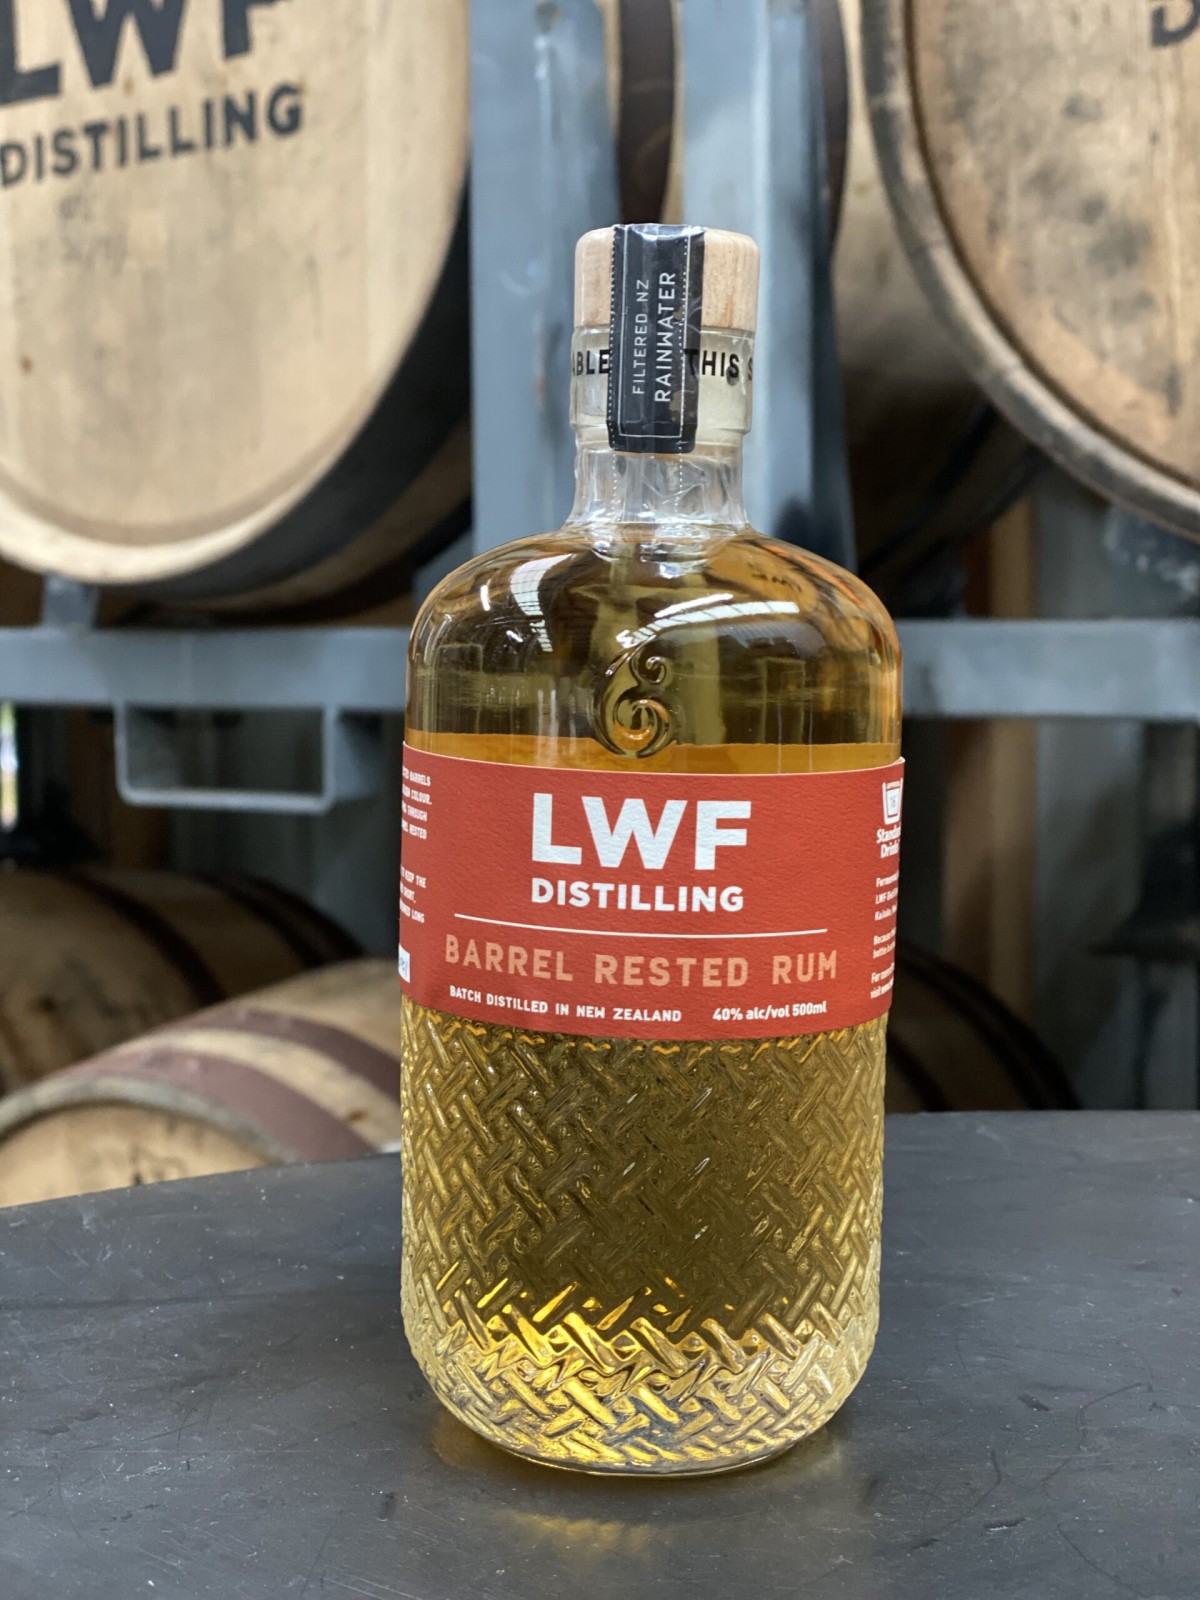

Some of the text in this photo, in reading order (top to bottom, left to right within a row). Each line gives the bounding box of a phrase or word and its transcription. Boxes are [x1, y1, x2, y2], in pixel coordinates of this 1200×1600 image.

[0, 82, 303, 188] DISTILLING
[573, 350, 610, 376] BLE
[684, 349, 739, 378] THIS
[632, 279, 649, 394] FILTERED NZ
[654, 272, 676, 402] RAINWATER
[531, 792, 751, 870] LWF
[531, 877, 744, 912] DISTILLING
[445, 934, 573, 981] BARREL
[594, 953, 749, 988] RESTED
[772, 949, 837, 985] RUM
[449, 985, 682, 1022] BATCH DISTILLED IN NEW ZEALAND
[712, 1000, 827, 1021] 40% alc/vol 500ml
